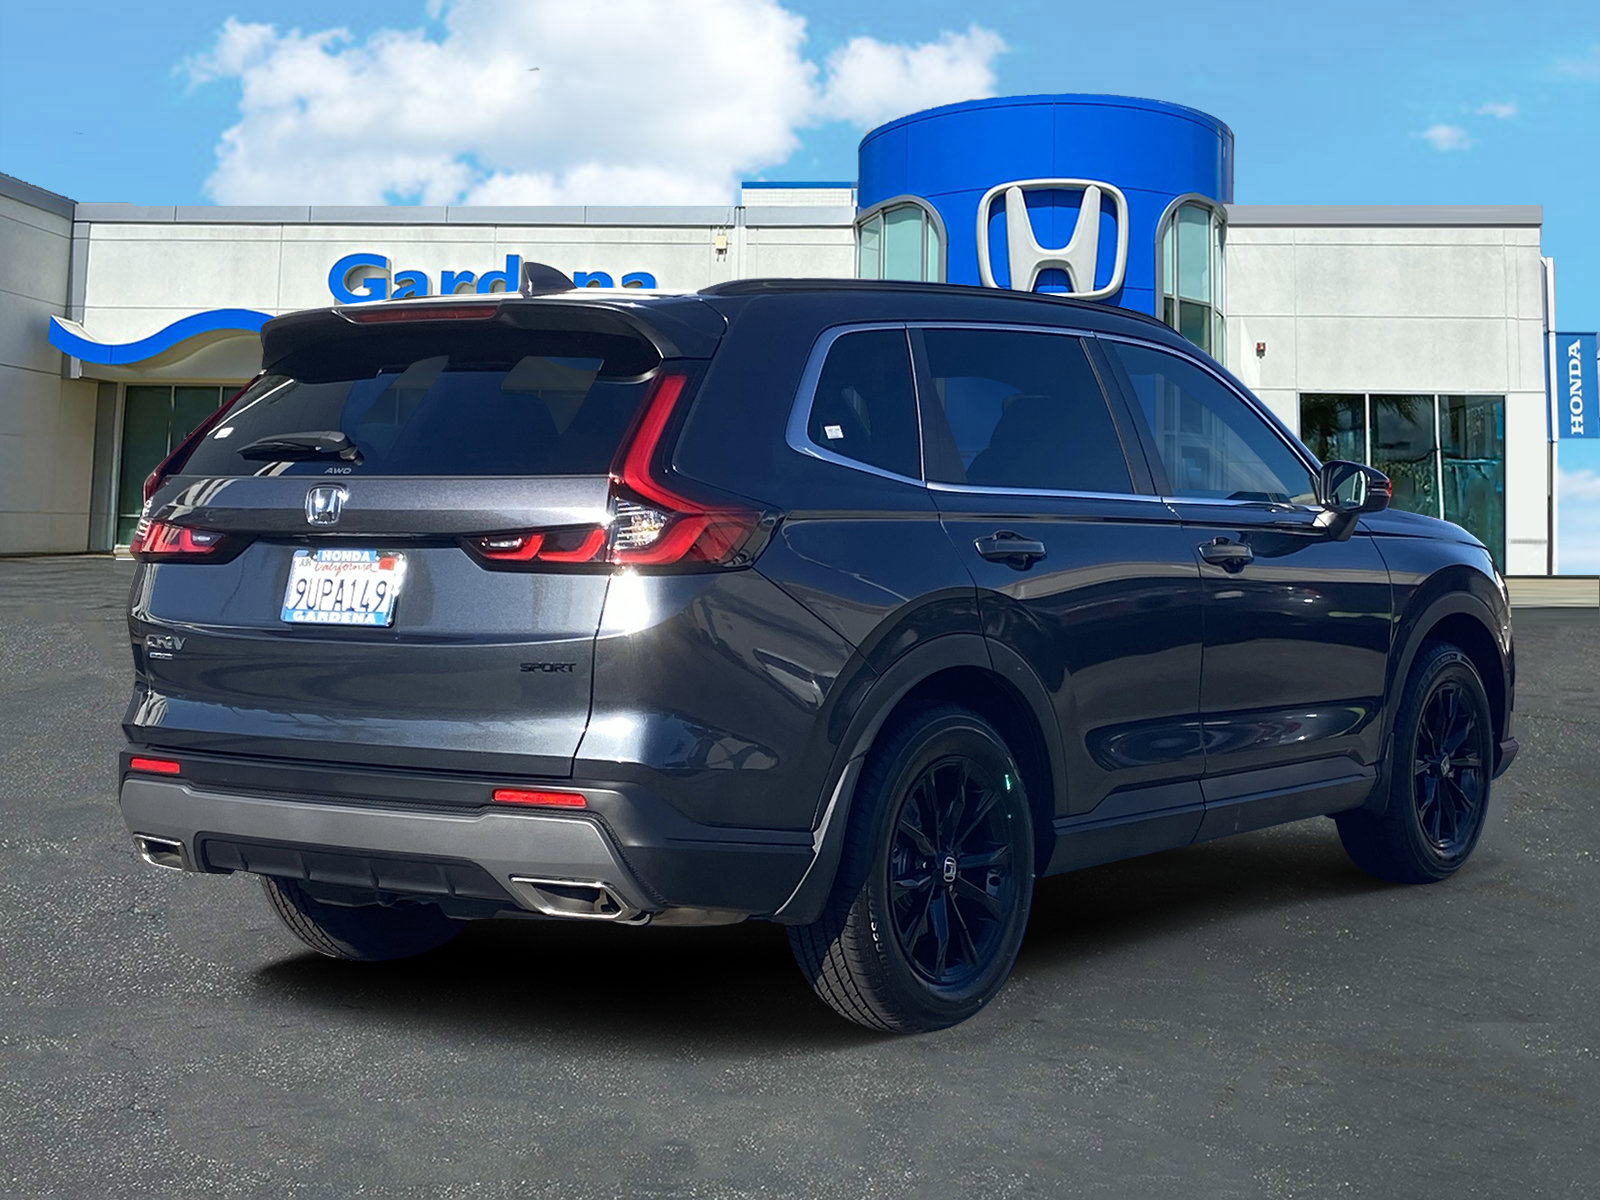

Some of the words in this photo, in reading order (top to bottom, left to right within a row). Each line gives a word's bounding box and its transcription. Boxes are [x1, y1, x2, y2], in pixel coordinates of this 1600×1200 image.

[328, 252, 657, 304] Gardna
[1568, 339, 1584, 435] HONDA
[321, 550, 370, 562] HONDA
[315, 561, 378, 577] California
[292, 578, 387, 612] 9UPA149
[293, 611, 376, 623] GARDENA
[520, 662, 576, 672] SPORT
